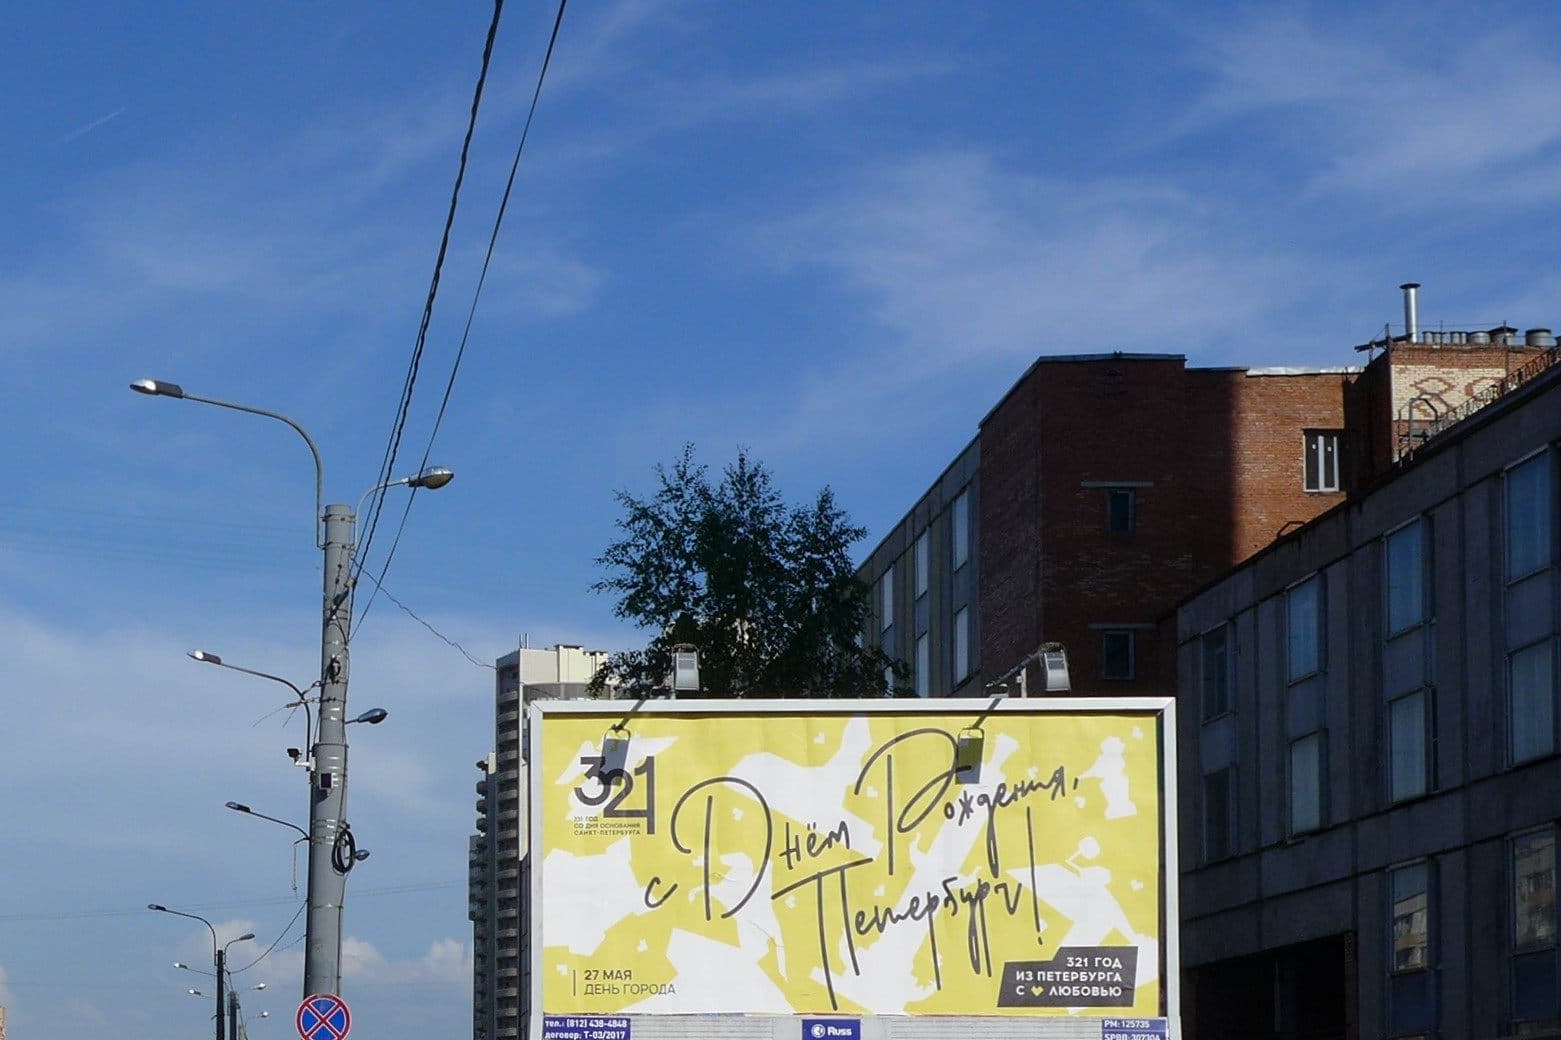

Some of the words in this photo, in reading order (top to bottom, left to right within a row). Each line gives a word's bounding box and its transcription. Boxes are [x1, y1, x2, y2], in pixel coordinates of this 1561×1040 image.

[574, 755, 656, 835] 321
[1066, 957, 1089, 967] 321
[1094, 957, 1123, 969] ГОД
[584, 969, 599, 981] 27
[602, 969, 632, 981] МАЯ
[1015, 971, 1033, 982] ИЗ
[1037, 971, 1123, 982] ПЕТЕРБУРГА
[584, 983, 620, 995] ДЕНЬ
[623, 983, 677, 995] ГОРОДА
[1015, 985, 1025, 996] С
[1048, 985, 1123, 997] ЛЮБОВЬЮ
[827, 1026, 852, 1036] Russ
